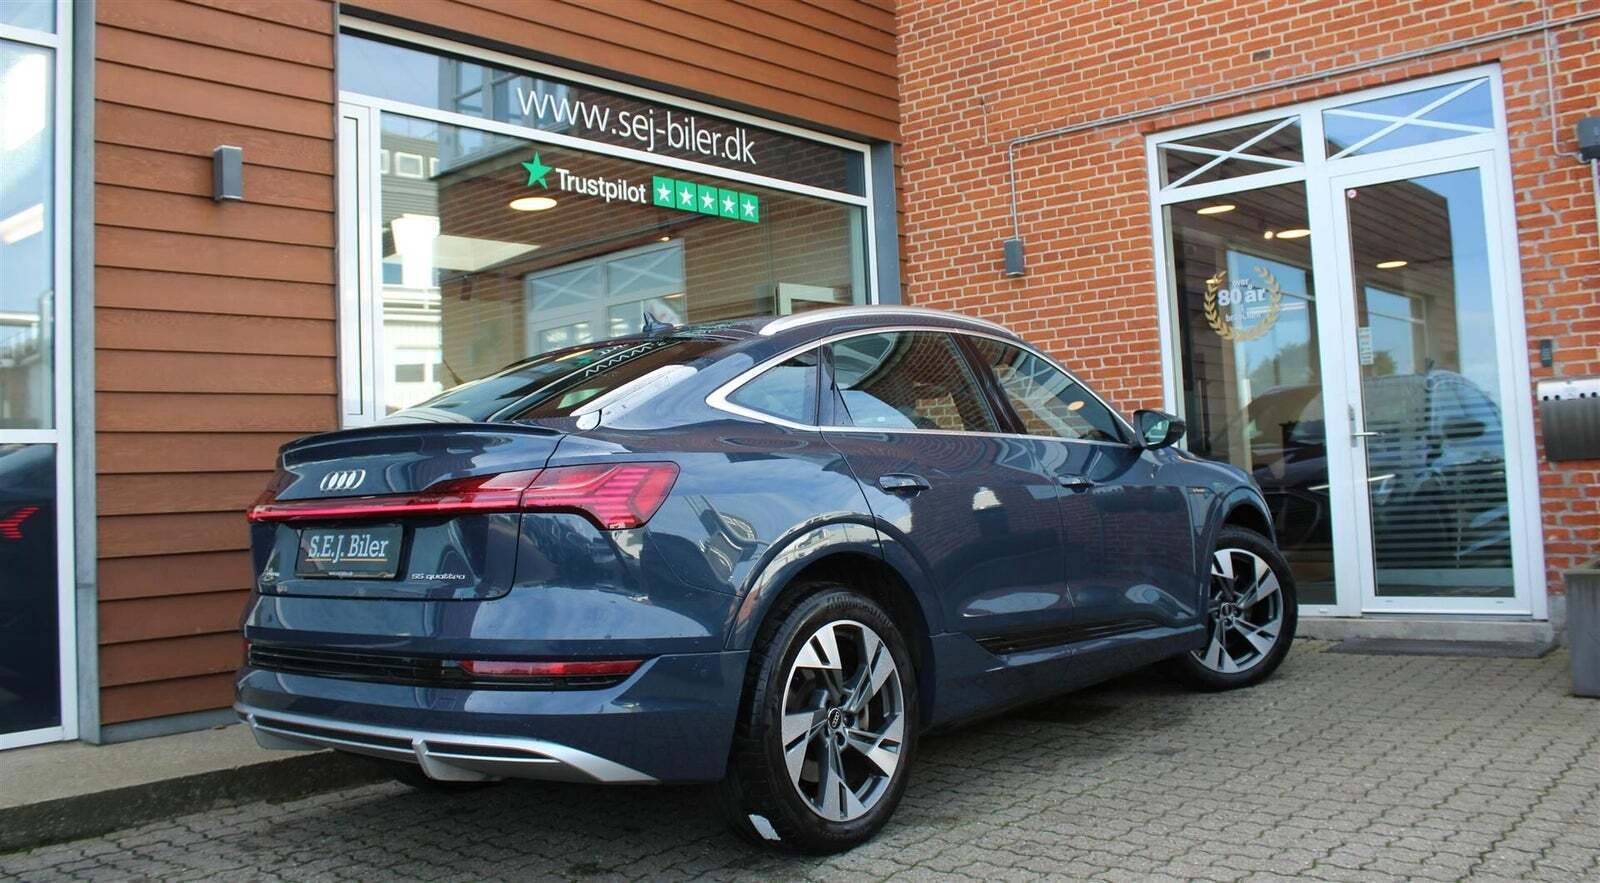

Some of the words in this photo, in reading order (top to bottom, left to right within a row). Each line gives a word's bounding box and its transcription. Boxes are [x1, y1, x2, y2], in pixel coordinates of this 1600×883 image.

[517, 87, 757, 165] www.sej-biler.dk
[555, 167, 647, 204] Trustpilot
[1217, 287, 1243, 306] 80
[1243, 283, 1267, 304] år
[308, 535, 344, 563] S.E.J.
[347, 534, 389, 557] Biler
[426, 573, 466, 581] quattro
